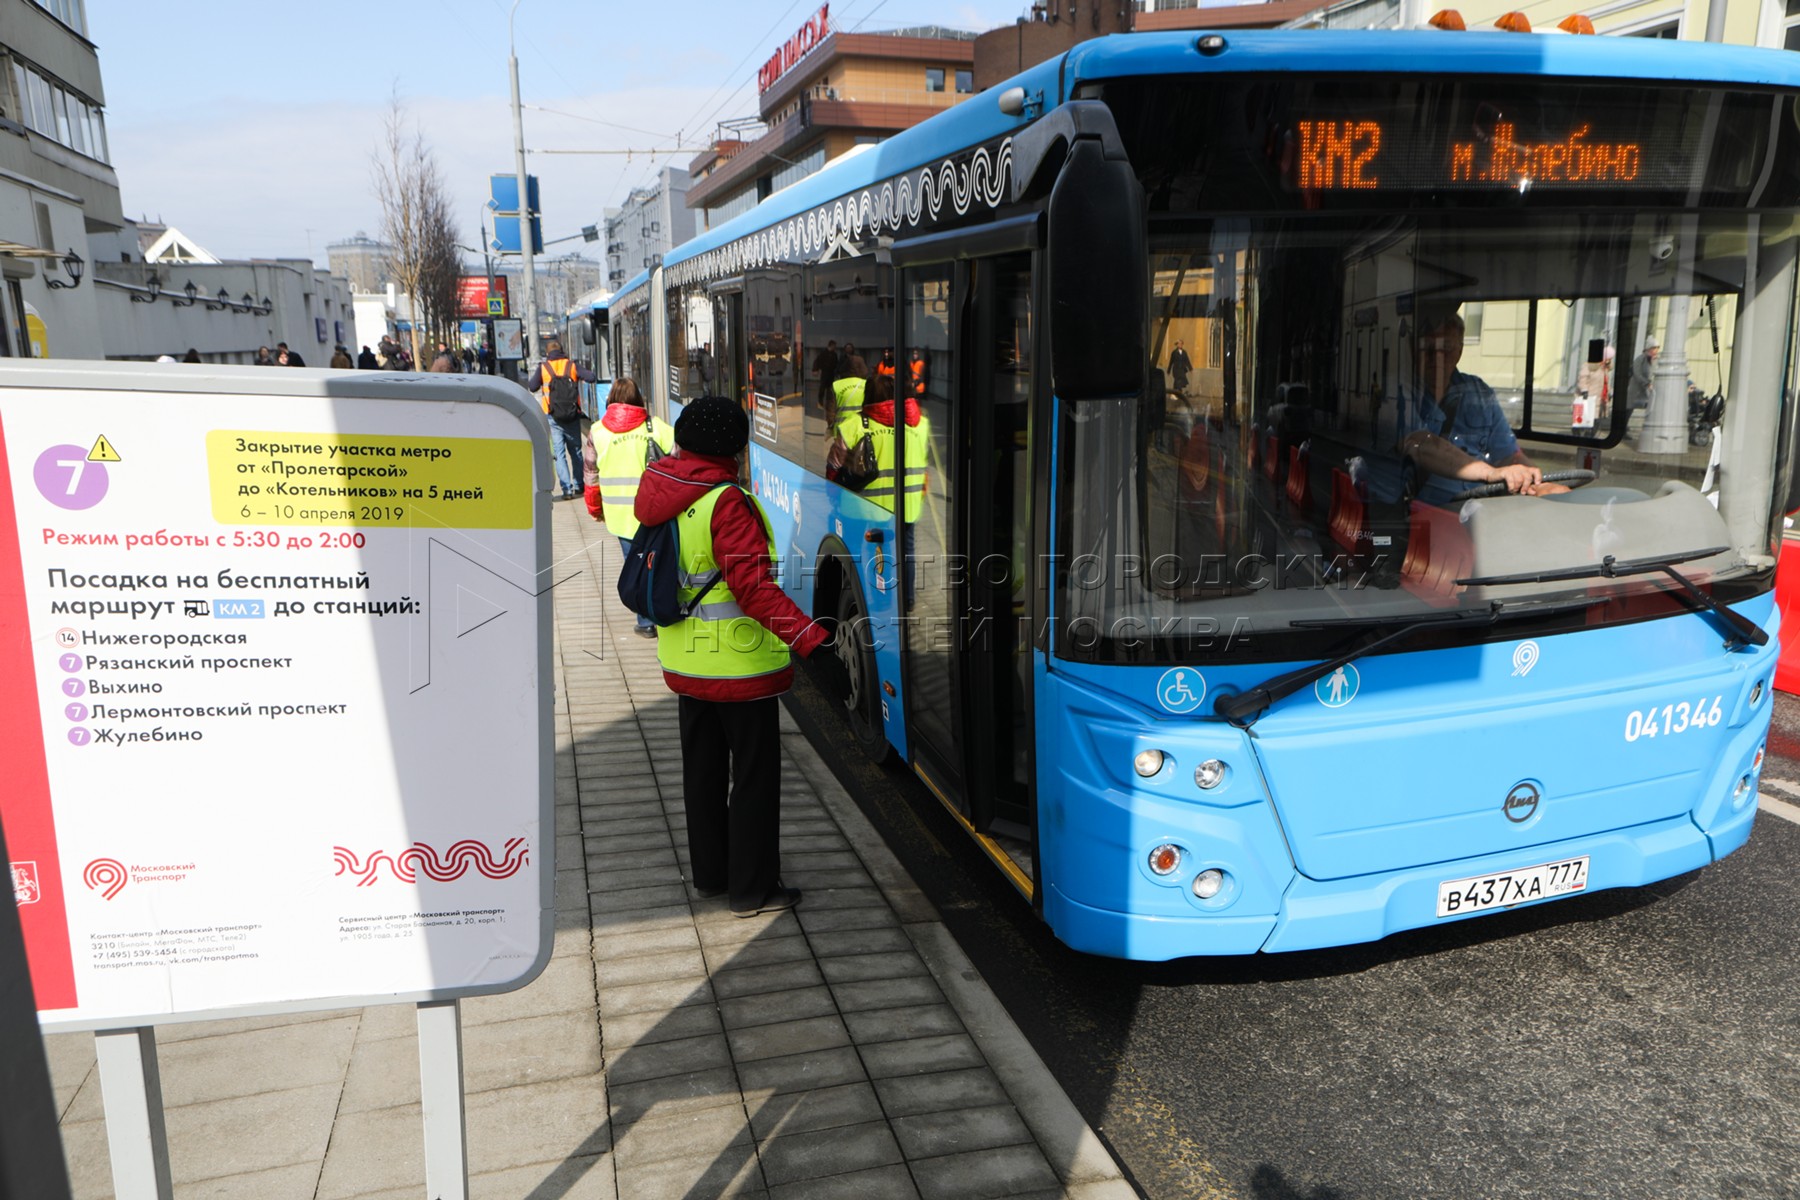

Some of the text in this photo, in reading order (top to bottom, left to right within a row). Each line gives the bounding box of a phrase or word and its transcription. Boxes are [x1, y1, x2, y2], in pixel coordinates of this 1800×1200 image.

[1300, 121, 1380, 189] КМ2
[235, 438, 452, 462] Закрытие участка метро
[55, 460, 86, 496] 7
[237, 460, 408, 480] от «Пролетарской»
[238, 482, 484, 501] до «Котельников» на 5 дней
[762, 468, 789, 514] 041346
[240, 504, 251, 518] 6
[274, 504, 294, 519] 10
[299, 508, 356, 523] апреля
[361, 506, 404, 520] 2019
[42, 528, 366, 550] Режим работы с 5:30 до 2:00
[48, 568, 370, 590] Посадка на бесплатный
[51, 596, 421, 621] маршрут КМ 2 до станций:
[61, 629, 247, 649] 14 Нижегородская
[66, 654, 293, 673] 7 Рязанский проспект
[69, 679, 163, 695] 7 Выхино
[72, 702, 347, 722] 7 Лермонтовский проспект
[1624, 695, 1723, 742] 041346
[74, 727, 203, 747] 7 Жулебино
[131, 862, 196, 873] Московский
[1550, 861, 1583, 886] 777
[131, 874, 186, 884] Транспорт
[1554, 882, 1572, 892] RUS
[338, 914, 382, 924] Сервисный
[384, 912, 407, 923] центр
[462, 907, 505, 917] транспорт»
[90, 923, 262, 940] Контакт-центр «Московский транспорт»
[92, 941, 116, 950] 3210
[106, 949, 131, 960] (495)
[134, 947, 178, 958] 539-5454
